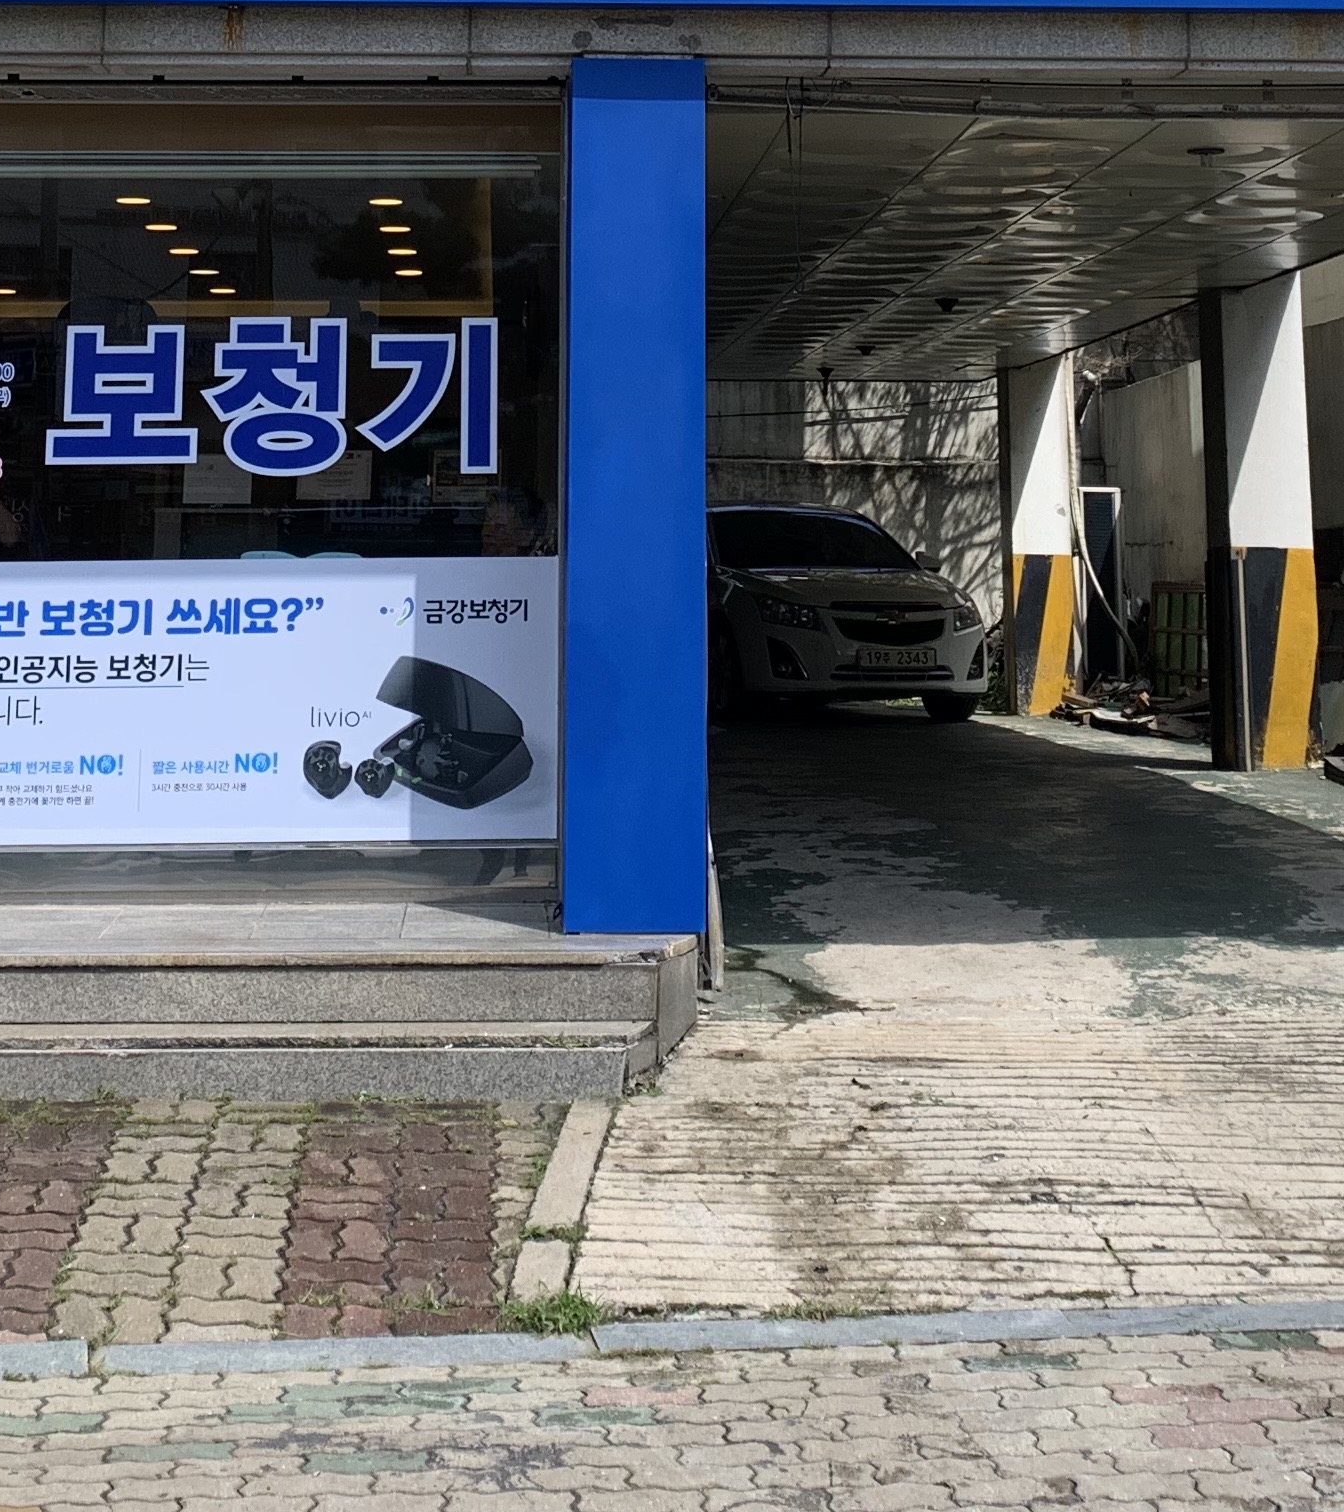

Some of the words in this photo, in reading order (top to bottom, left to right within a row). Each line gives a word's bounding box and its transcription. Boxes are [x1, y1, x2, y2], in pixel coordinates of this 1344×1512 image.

[45, 316, 498, 477] 보청기
[40, 598, 154, 637] 보청기
[423, 598, 529, 624] 금강보청기
[107, 652, 210, 683] 보청기는
[897, 651, 928, 665] 2343
[26, 761, 74, 774] 번거로움
[79, 754, 123, 775] NO!
[152, 761, 177, 774] 짧은
[181, 760, 230, 774] 사용시간
[234, 752, 278, 774] NO!
